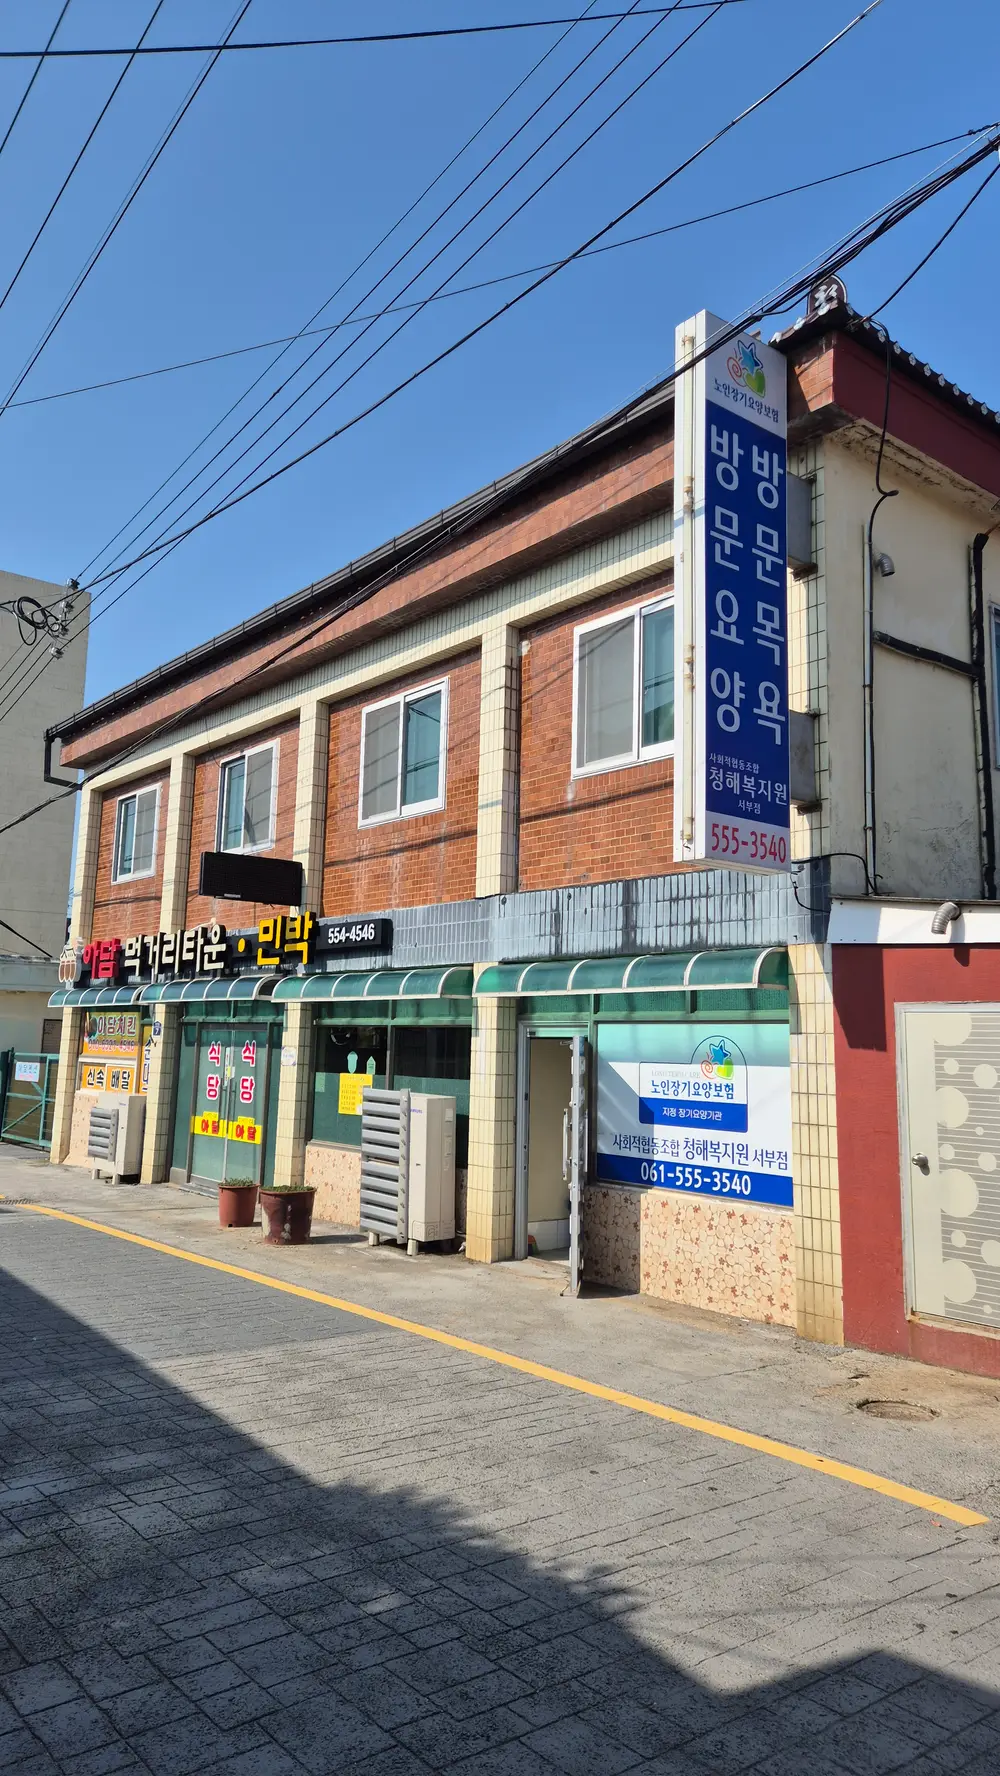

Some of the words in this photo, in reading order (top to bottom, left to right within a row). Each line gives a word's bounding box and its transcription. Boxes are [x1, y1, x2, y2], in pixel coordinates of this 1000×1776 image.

[714, 378, 779, 423] 노인장기요양보험
[710, 424, 746, 733] 방문요양
[752, 444, 786, 745] 방문목욕
[709, 753, 760, 774] 사회적협동조합
[709, 766, 787, 805] 청해복지원
[738, 800, 761, 814] 서부점
[711, 823, 787, 863] 555-3540
[83, 938, 118, 980] 아담
[124, 924, 227, 977] 먹거리타운
[256, 911, 313, 966] 민박
[328, 923, 375, 944] 554-4546
[97, 1016, 137, 1036] 아담치킨
[87, 1068, 105, 1087] 신속
[110, 1070, 131, 1090] 배달
[651, 1080, 735, 1100] 노인장기요양보험
[662, 1107, 677, 1117] 지정
[678, 1108, 722, 1121] 장기요양기관
[612, 1134, 680, 1157] 사회적협동조합
[683, 1138, 749, 1167] 청해복지원
[752, 1151, 788, 1171] 서부점
[641, 1161, 752, 1196] 061-555-3540
